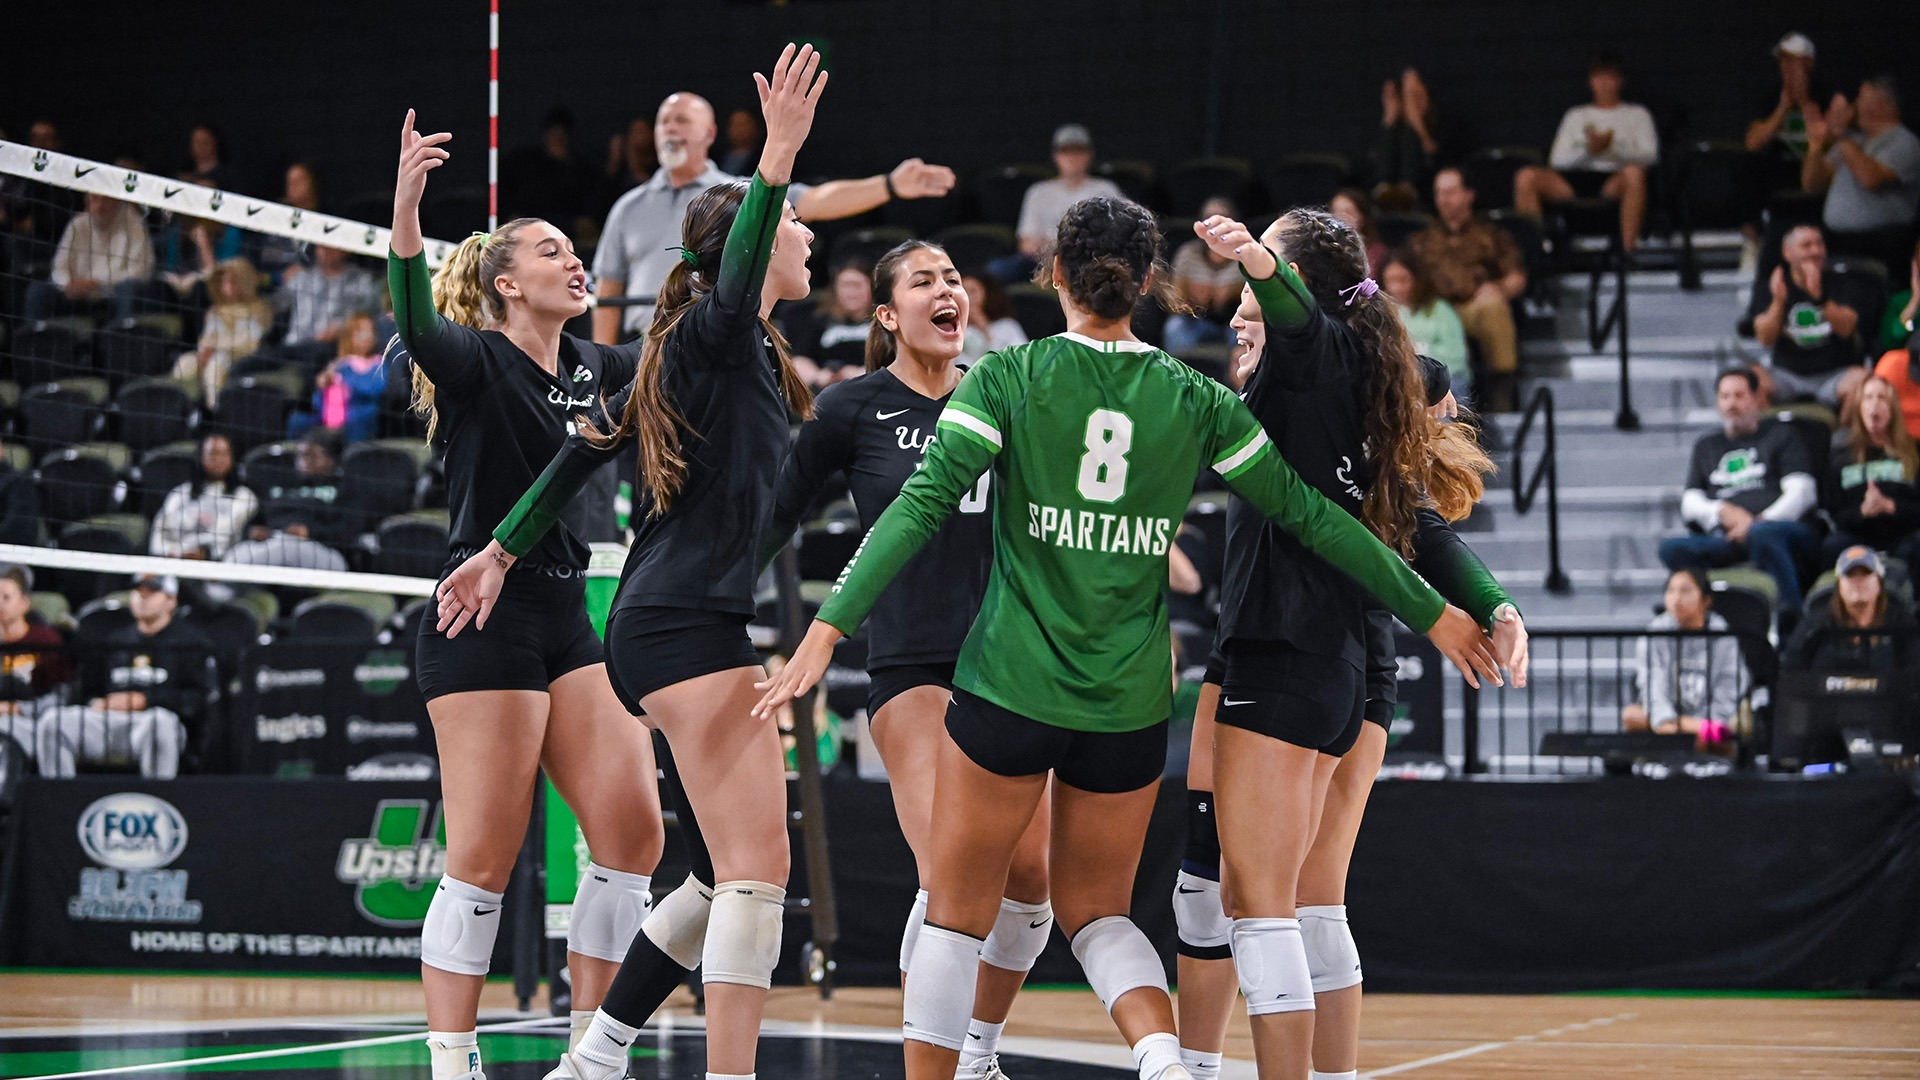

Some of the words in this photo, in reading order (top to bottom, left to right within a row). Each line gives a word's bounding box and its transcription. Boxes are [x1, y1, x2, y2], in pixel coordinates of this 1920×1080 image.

[1076, 407, 1134, 504] 8
[1028, 502, 1170, 556] SPARTANS
[104, 813, 158, 838] FOX
[340, 840, 447, 881] Upsta
[131, 931, 204, 952] HOME
[207, 933, 242, 953] OF
[244, 935, 292, 956] THE
